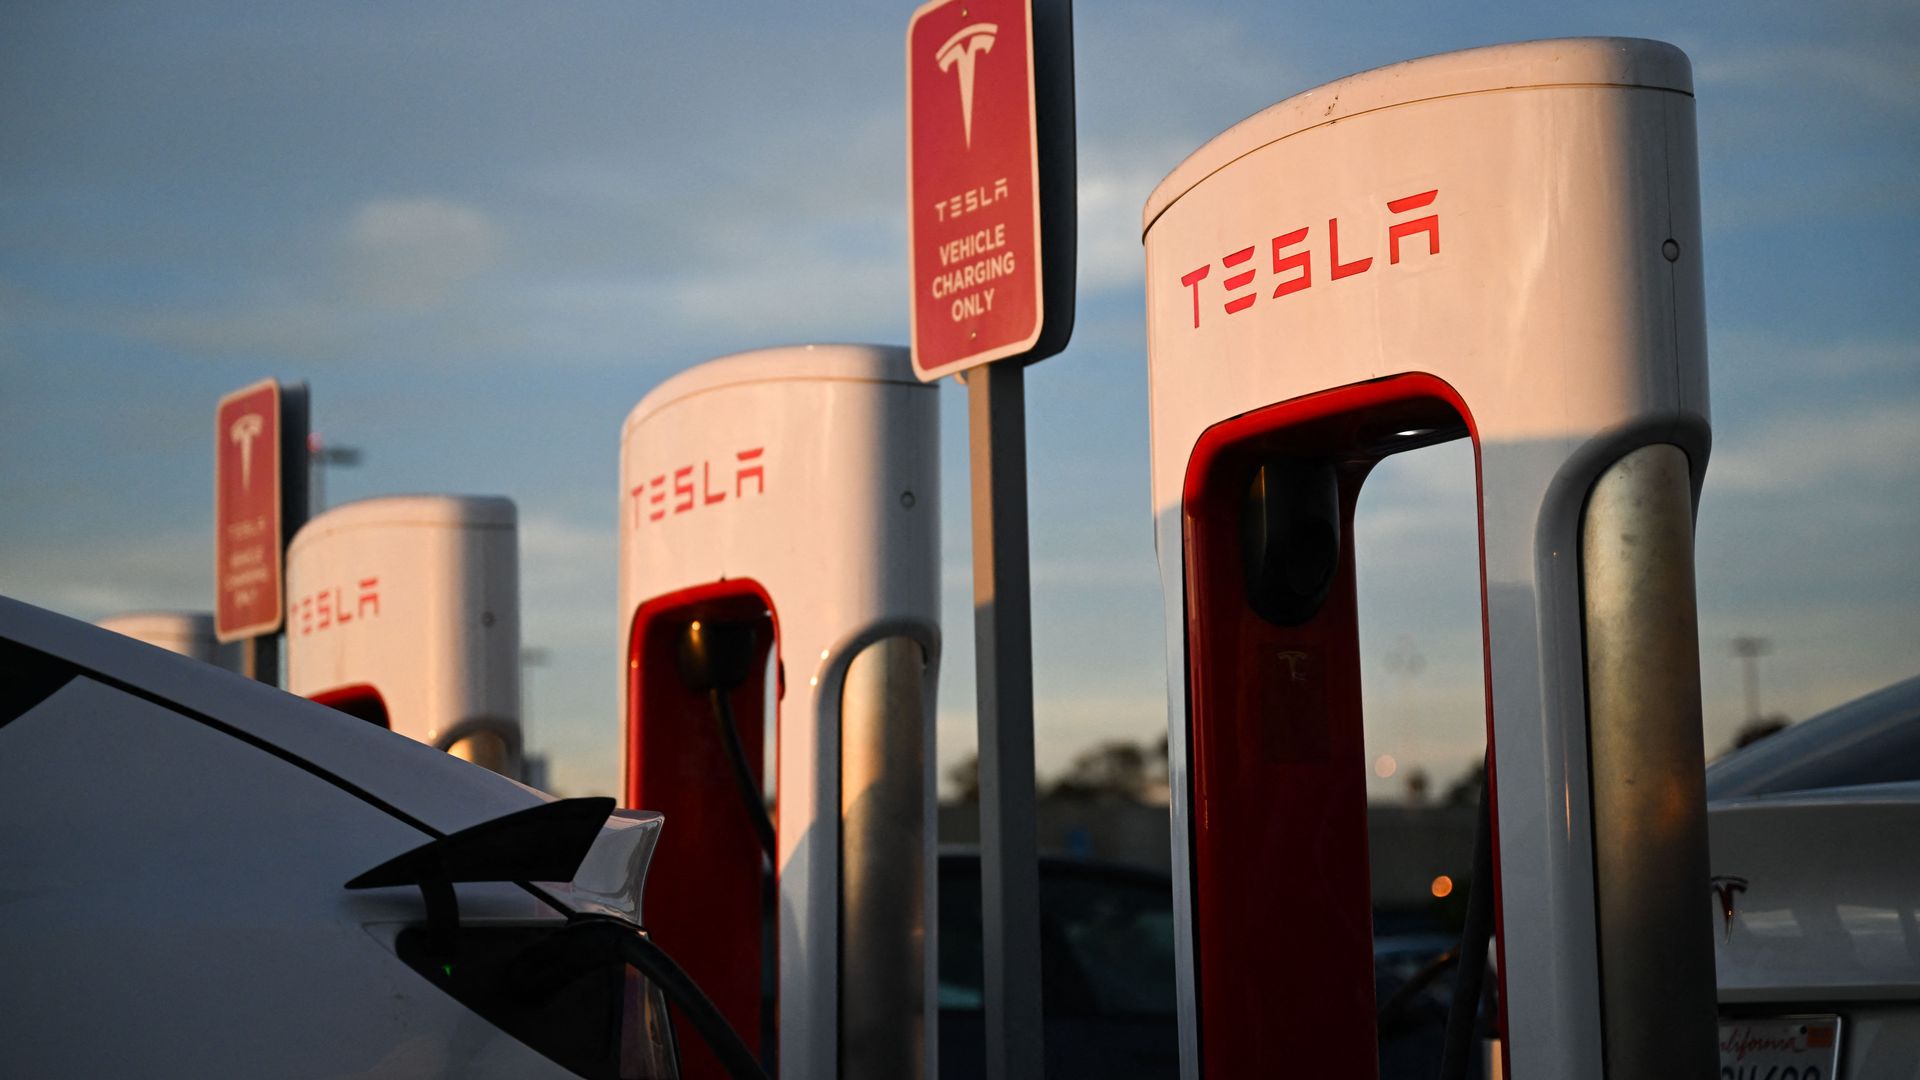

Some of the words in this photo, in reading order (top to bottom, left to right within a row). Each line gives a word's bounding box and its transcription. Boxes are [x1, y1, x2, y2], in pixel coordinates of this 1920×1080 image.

[935, 178, 1009, 222] TESLA
[939, 224, 1006, 266] VEHICLE
[1181, 189, 1440, 329] TESLA
[932, 252, 1016, 298] CHARGING
[952, 288, 995, 322] ONLY
[631, 447, 764, 530] TESLA
